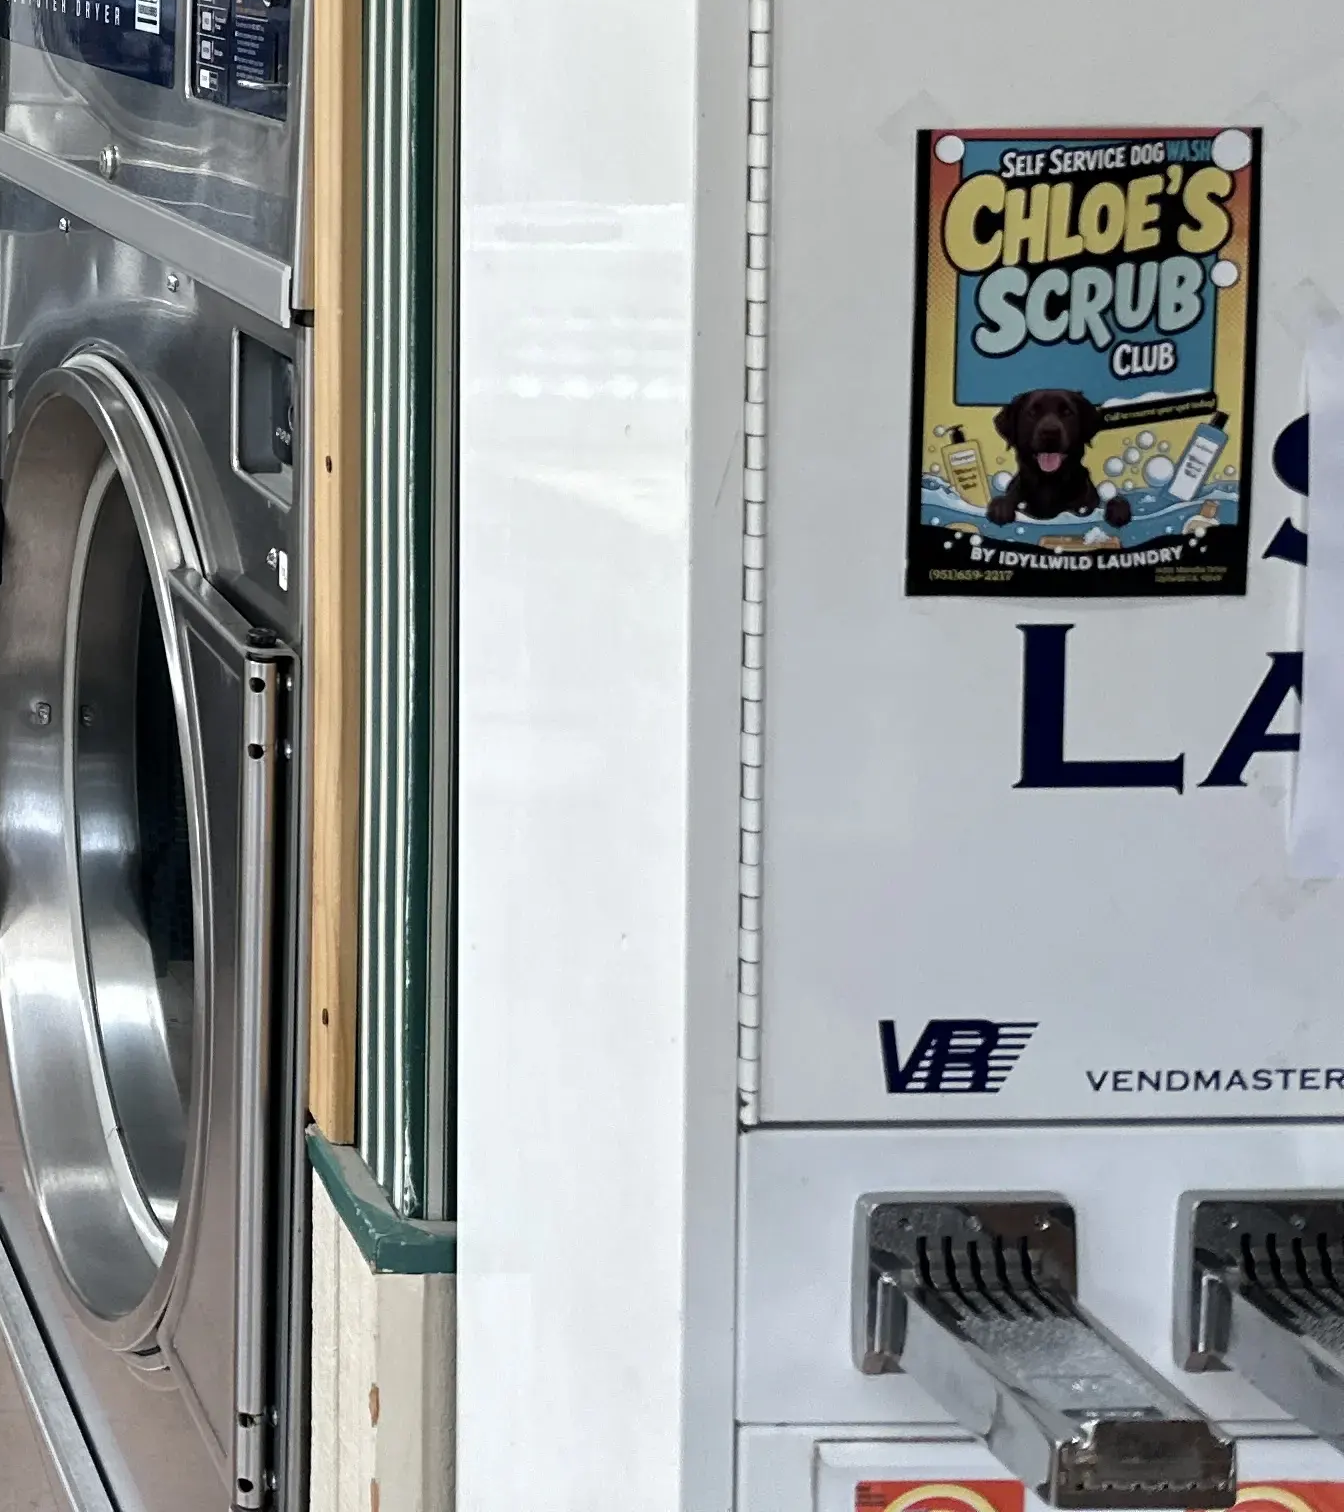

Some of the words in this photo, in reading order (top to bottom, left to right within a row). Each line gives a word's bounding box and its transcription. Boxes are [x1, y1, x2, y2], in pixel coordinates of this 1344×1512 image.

[1001, 151, 1046, 179] SELF
[1048, 145, 1126, 175] SERVICE
[1130, 142, 1165, 166] DOG
[1165, 139, 1212, 162] WASH
[944, 165, 1236, 274] CHLOE'S
[974, 255, 1205, 355] SCRUB
[1113, 341, 1176, 377] CLUB
[970, 547, 996, 563] BY
[999, 550, 1092, 570] IDYLLWILD
[1097, 545, 1183, 569] LAUNDRY
